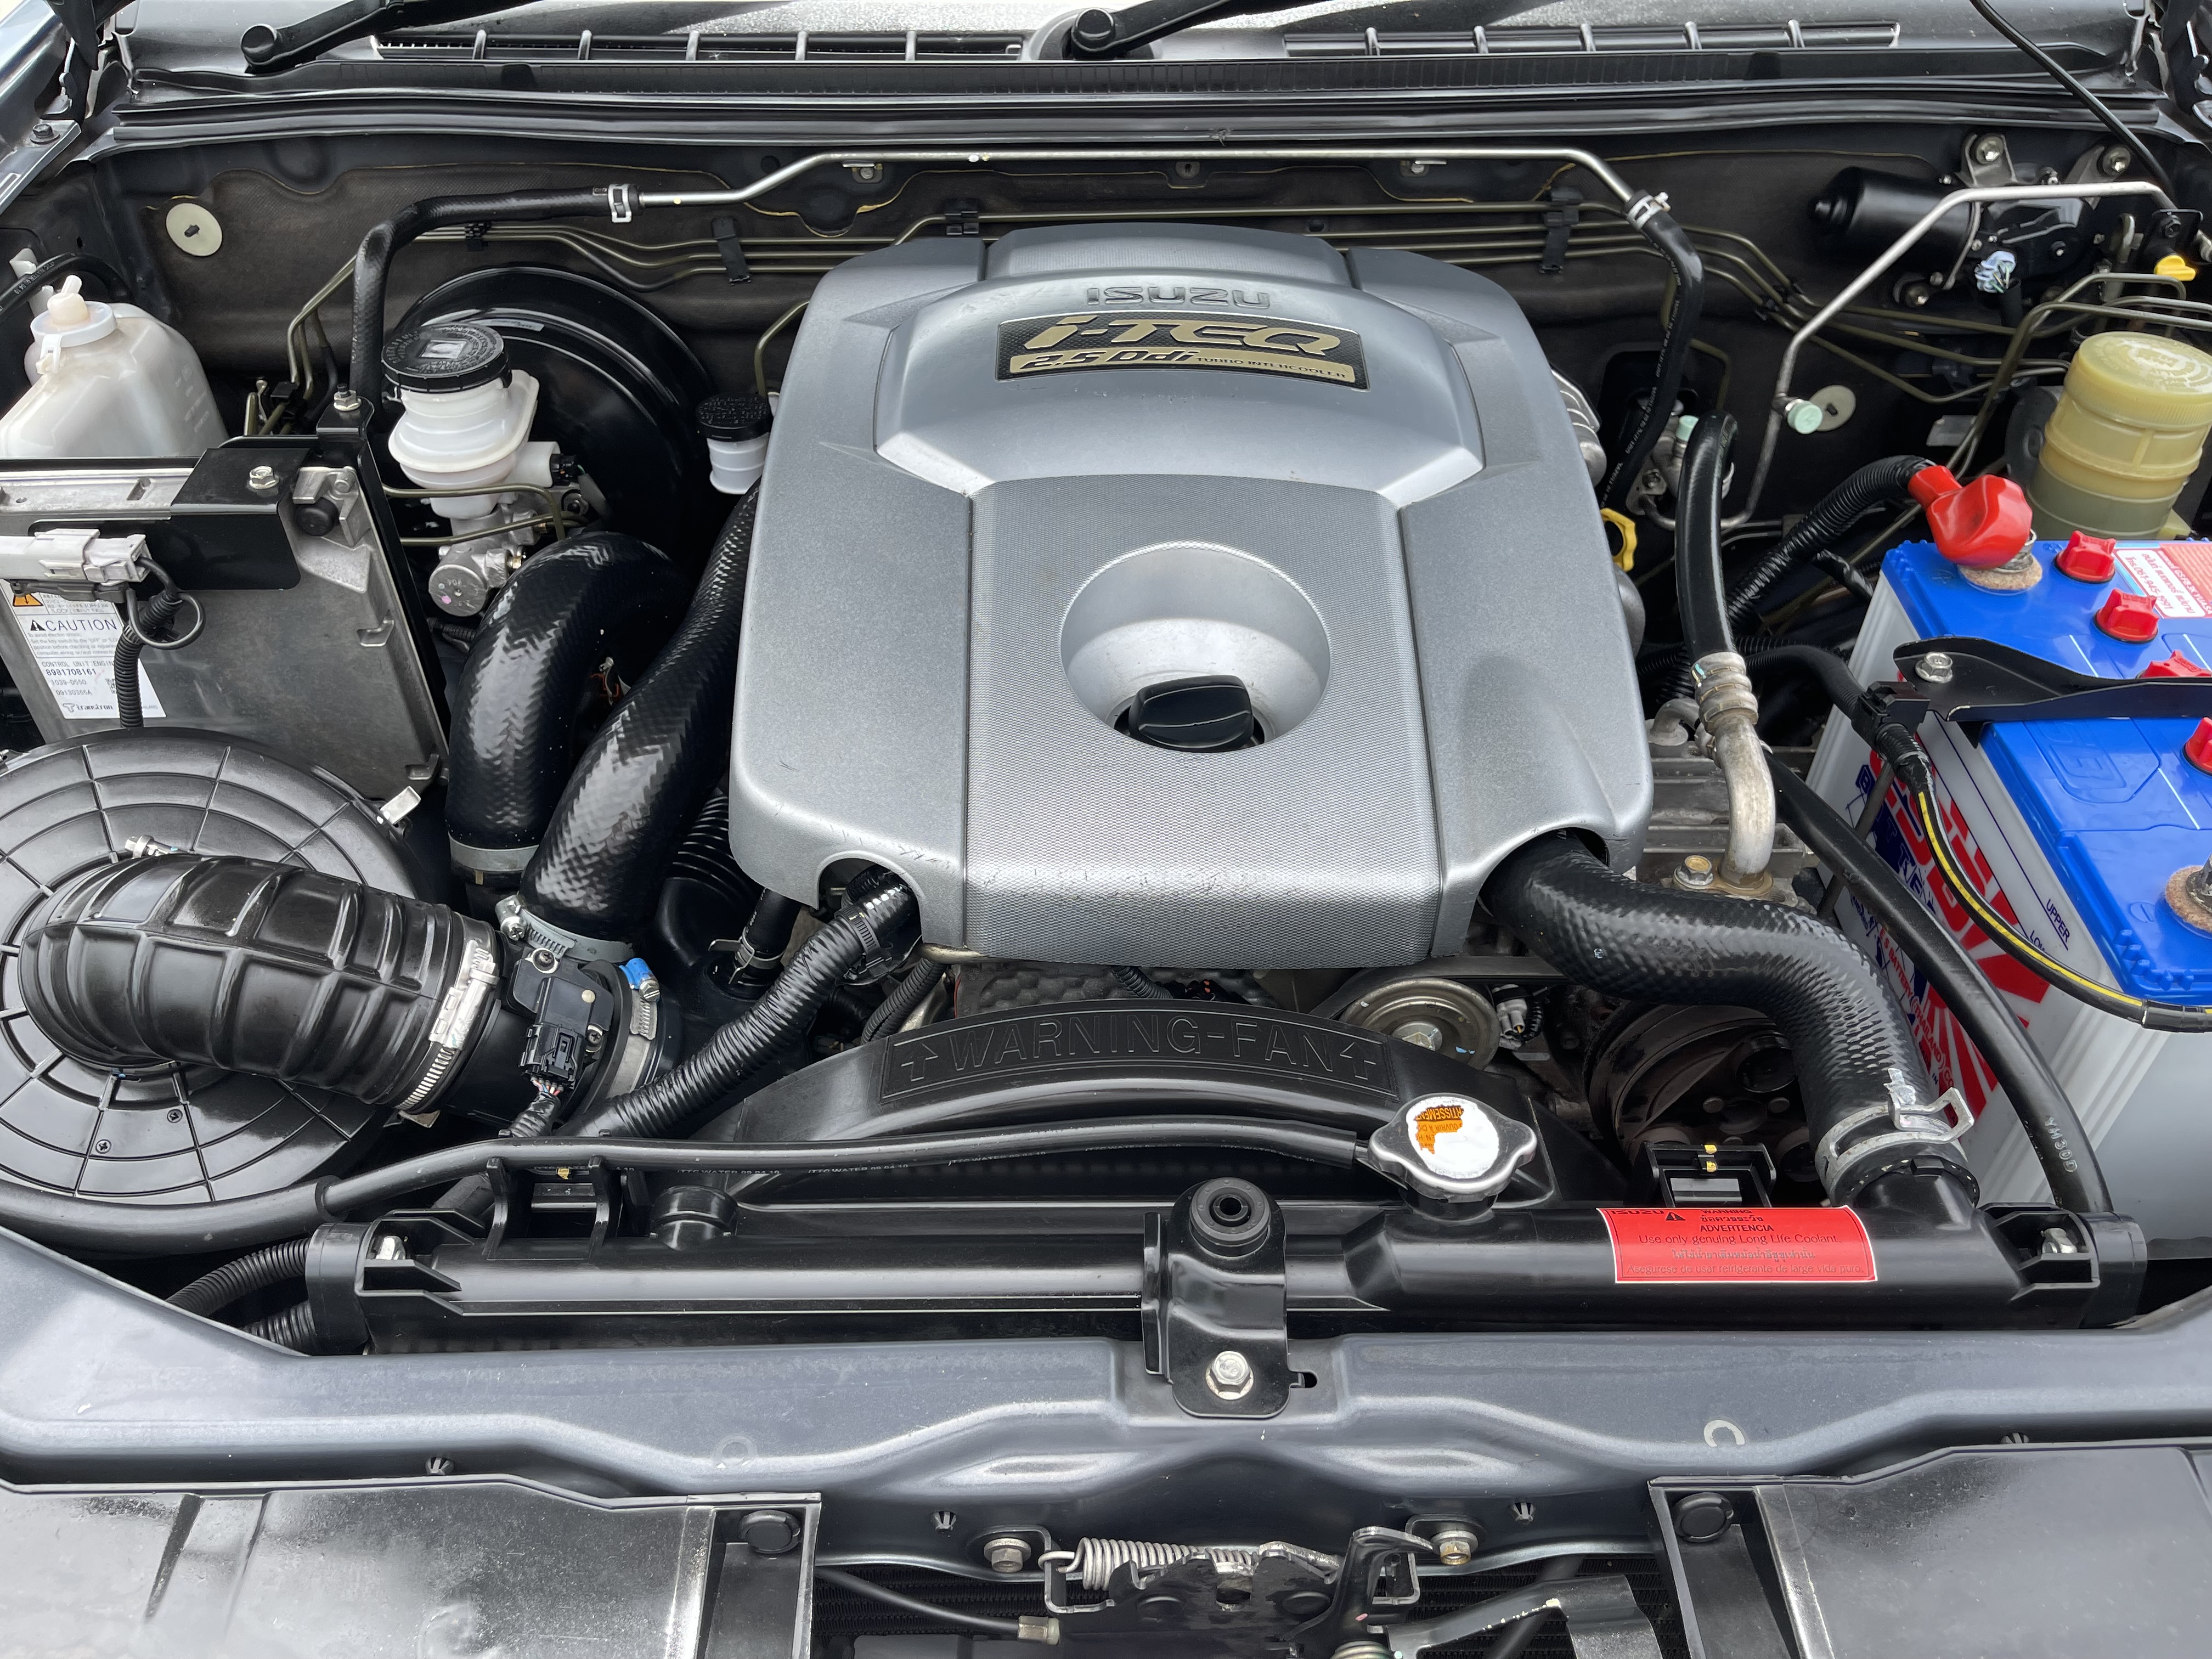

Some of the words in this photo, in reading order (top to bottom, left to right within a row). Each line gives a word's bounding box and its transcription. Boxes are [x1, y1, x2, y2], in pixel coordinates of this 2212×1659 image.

[1087, 286, 1271, 309] ISUZU
[1019, 350, 1108, 370] 2.5
[1104, 349, 1200, 365] Ddi
[1195, 357, 1244, 365] TURBO
[1247, 360, 1346, 378] INTERCOOLER
[46, 619, 117, 631] CAUTION
[2046, 899, 2070, 941] UPPER
[1888, 949, 1914, 999] BATTERY
[947, 1013, 1334, 1074] WARNING-FAN
[1435, 1123, 1458, 1131] OUVRIR
[2045, 1116, 2078, 1172] YH30D
[1639, 1234, 1662, 1244] Use
[1664, 1234, 1688, 1245] only
[1740, 1234, 1768, 1245] Long
[1771, 1234, 1793, 1243] Life
[1680, 1264, 1693, 1273] de
[1696, 1265, 1716, 1273] usar
[1718, 1263, 1773, 1274] refrigerante
[1775, 1263, 1787, 1273] de
[1790, 1263, 1814, 1274] large
[1816, 1263, 1837, 1273] vida
[1839, 1265, 1864, 1274] puro.
